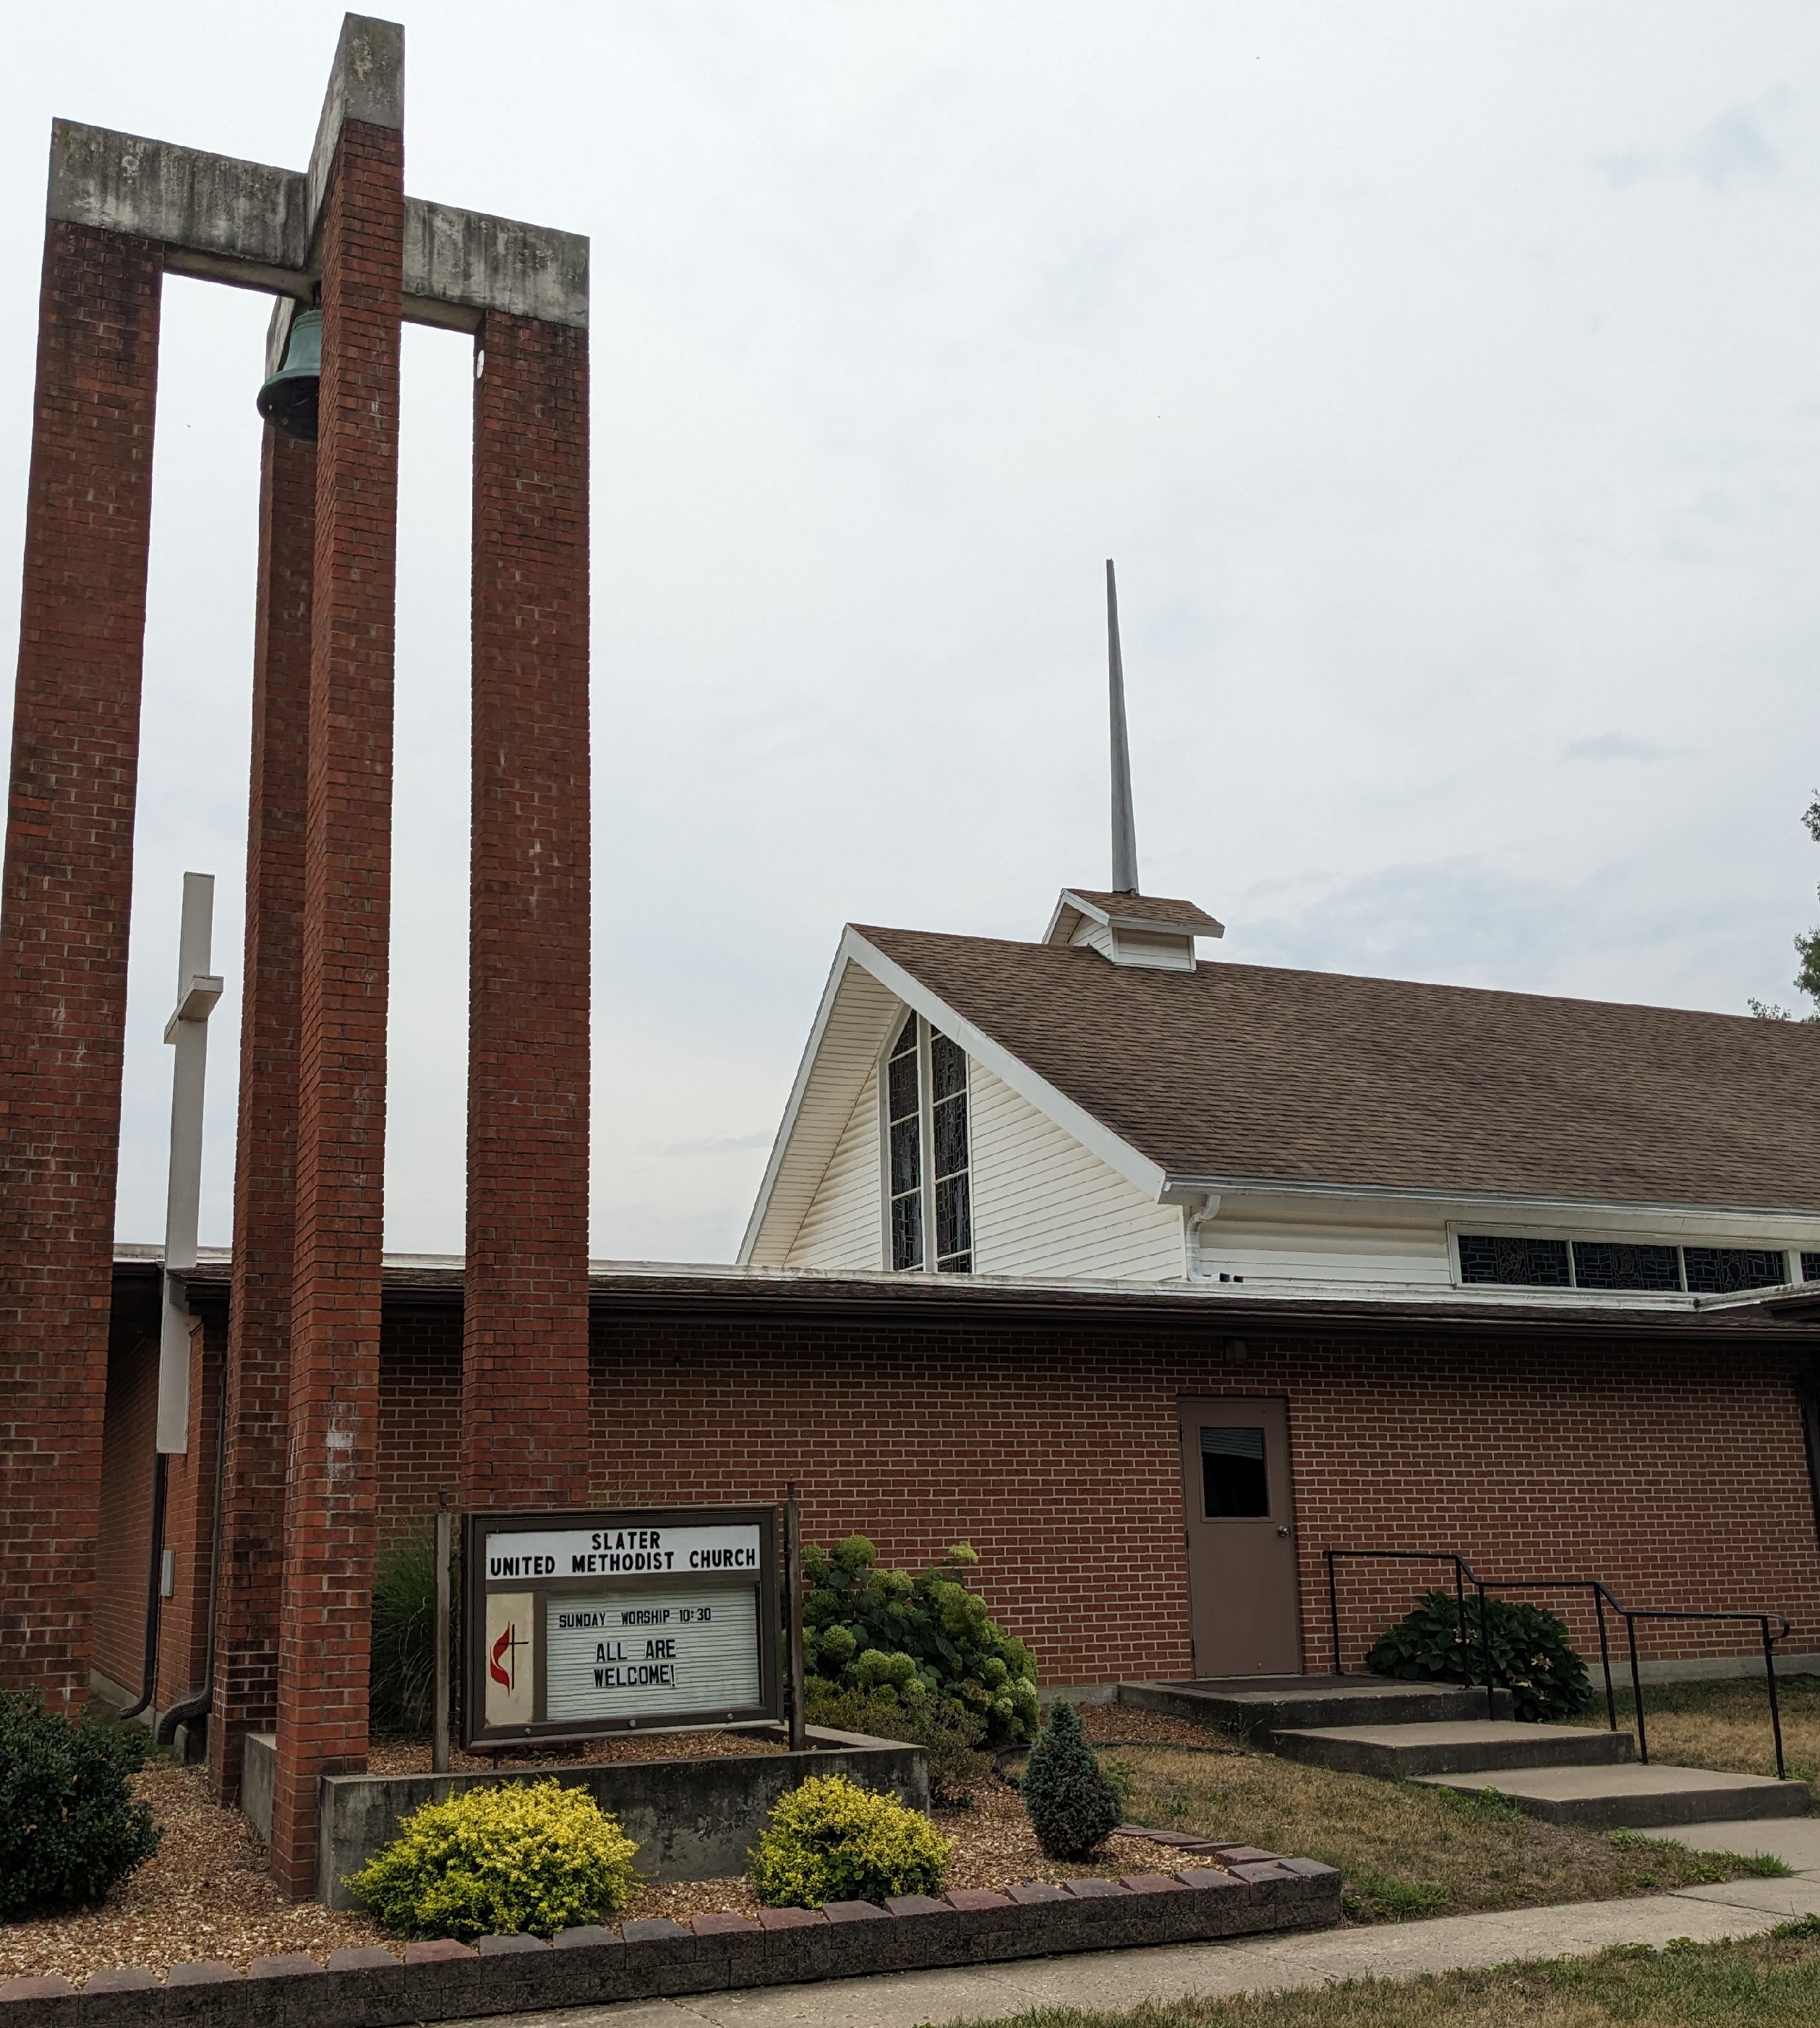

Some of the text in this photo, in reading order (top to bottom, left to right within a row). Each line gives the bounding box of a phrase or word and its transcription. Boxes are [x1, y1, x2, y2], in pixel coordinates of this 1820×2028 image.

[591, 1531, 661, 1551] SLATER
[490, 1548, 756, 1576] UNITED METHODIST CHURCH
[559, 1607, 712, 1628] SUNDAY WORSHIP 10:30
[596, 1639, 676, 1662] ALL ARE
[594, 1664, 676, 1687] WELCOME!
